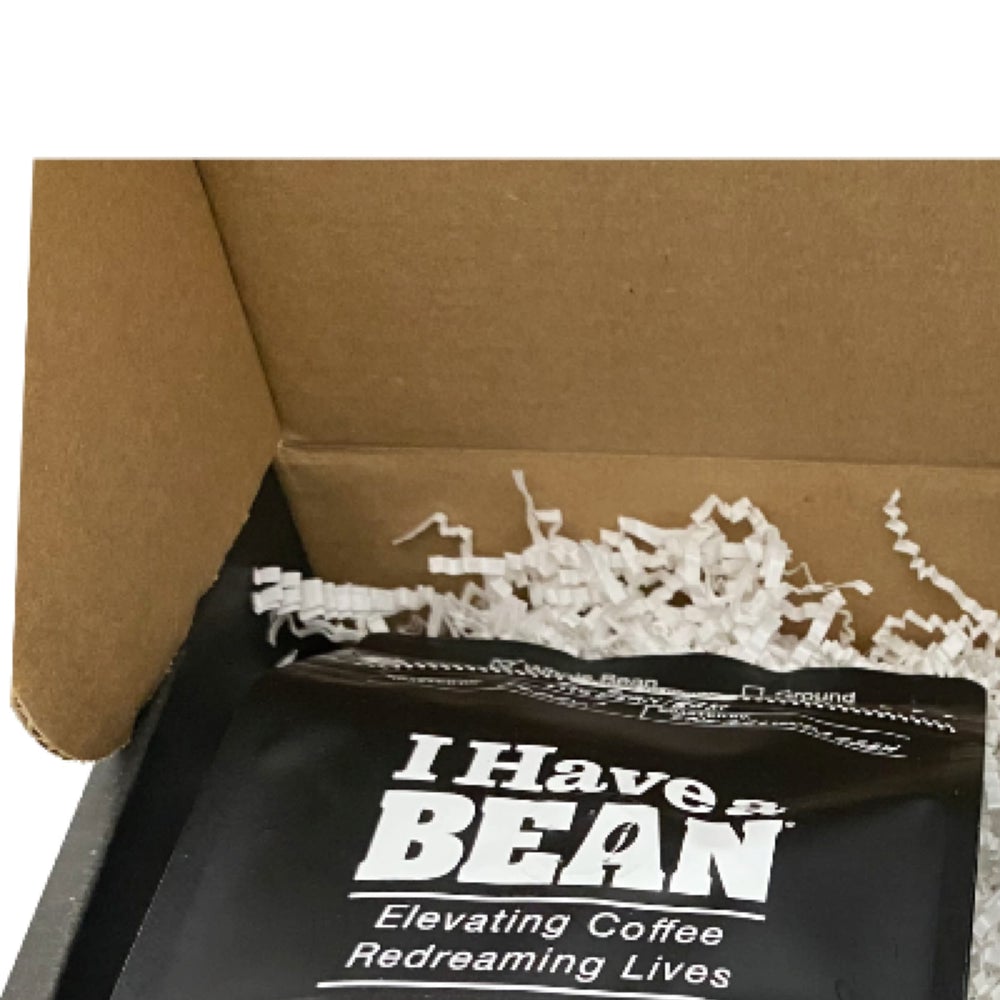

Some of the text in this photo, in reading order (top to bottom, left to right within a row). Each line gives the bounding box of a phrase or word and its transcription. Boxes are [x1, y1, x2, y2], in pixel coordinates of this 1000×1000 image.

[392, 733, 788, 816] I Have a
[353, 789, 784, 903] BEAN
[375, 904, 725, 947] Elevating Coffee
[345, 942, 732, 990] Redreaming Lives
